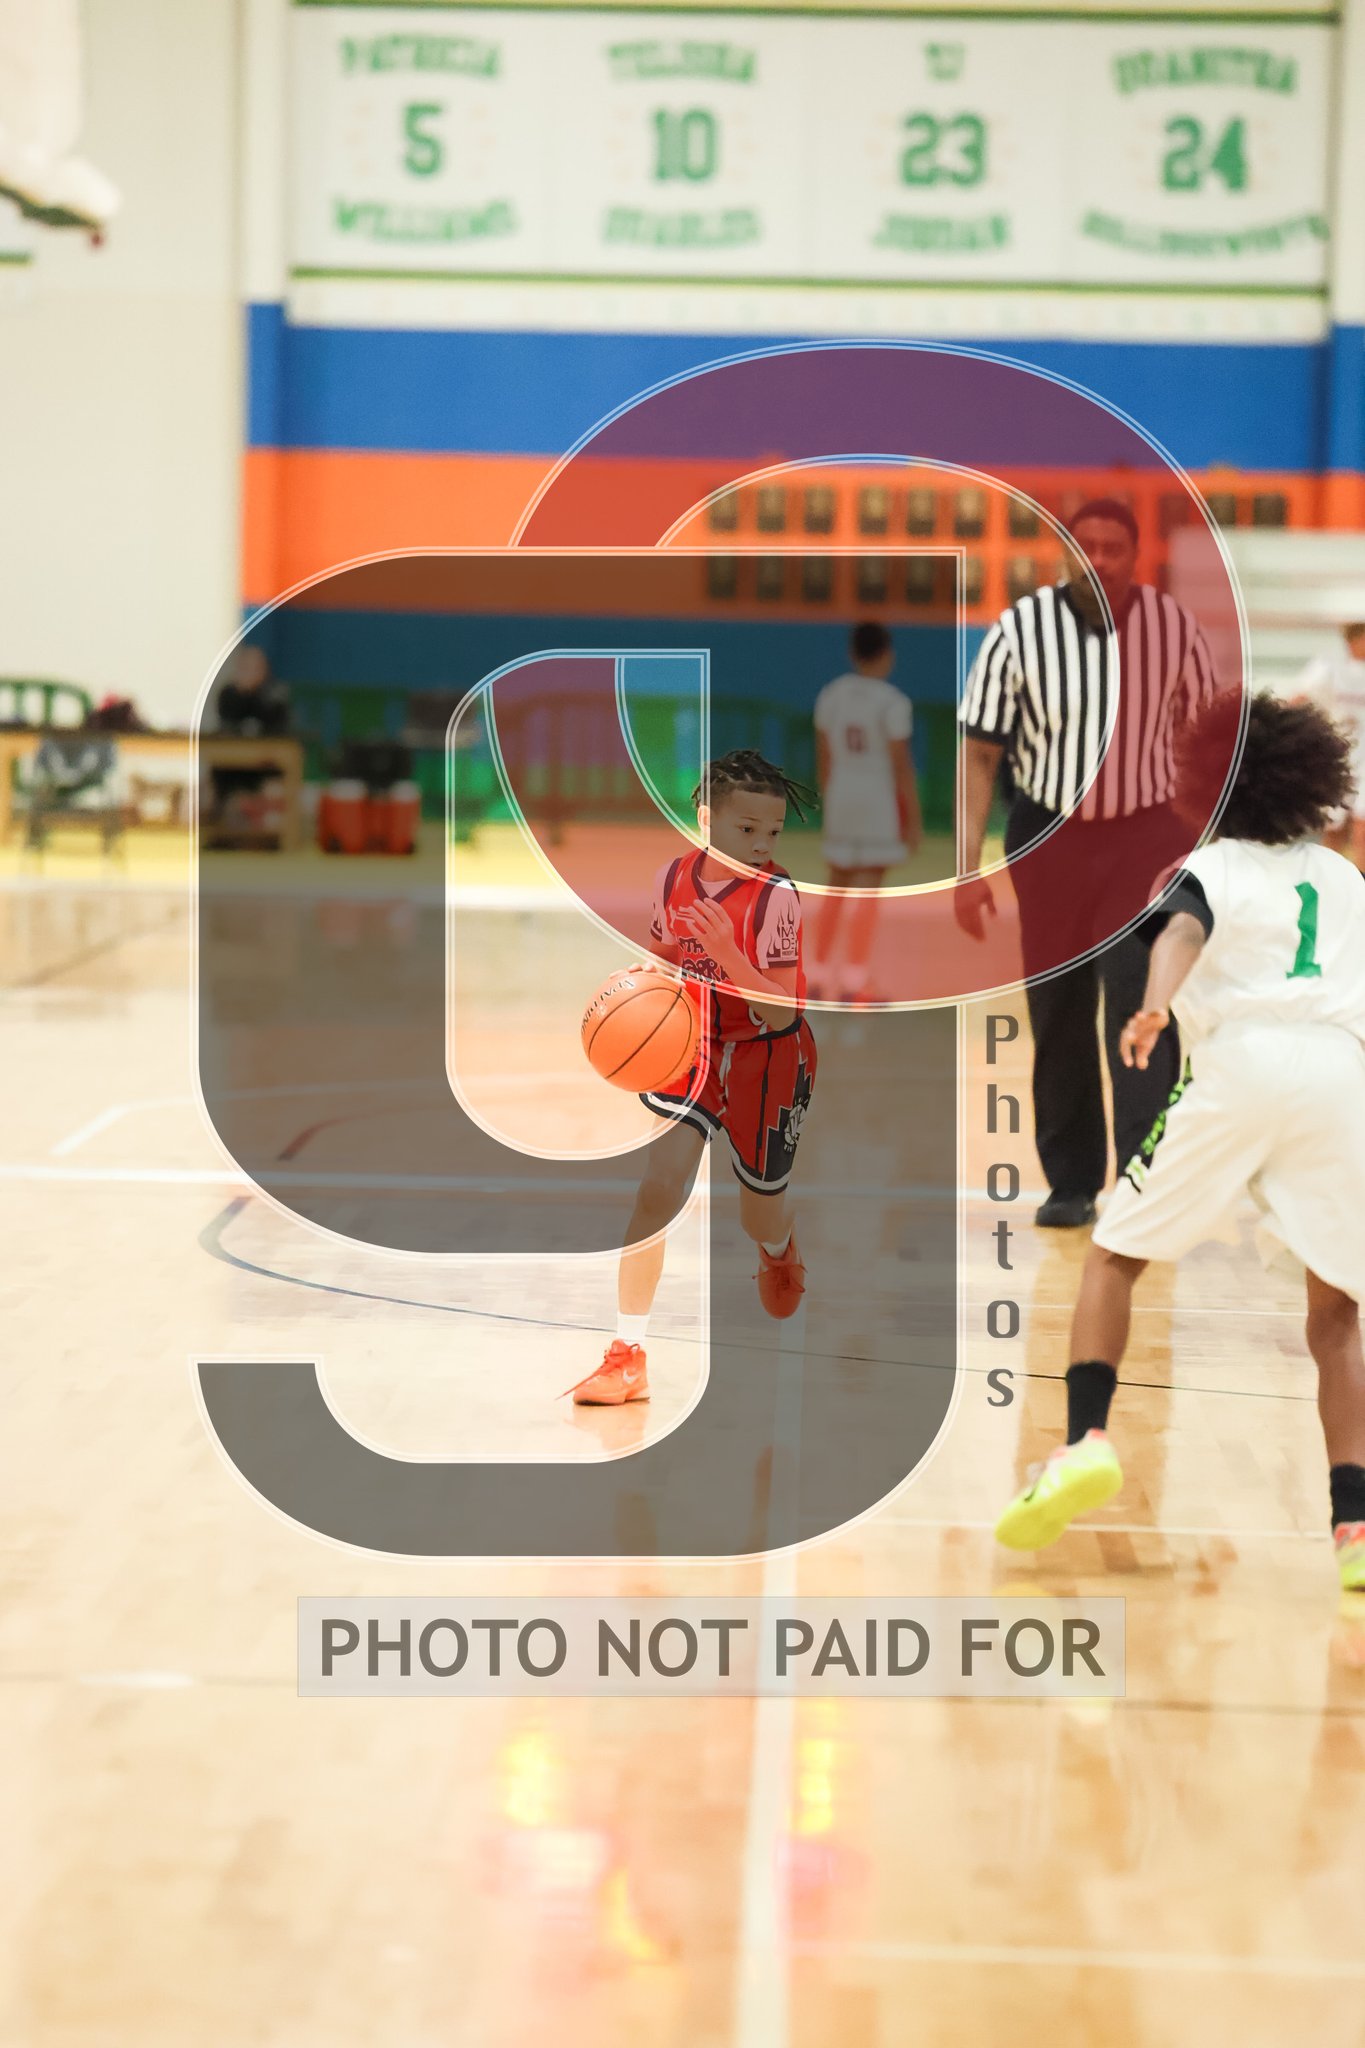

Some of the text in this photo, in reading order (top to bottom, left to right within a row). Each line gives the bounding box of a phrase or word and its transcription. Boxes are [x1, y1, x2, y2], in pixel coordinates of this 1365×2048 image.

[402, 101, 443, 179] 5
[651, 106, 719, 184] 10
[899, 110, 987, 189] 23
[1162, 113, 1248, 194] 24
[1285, 880, 1323, 979] 1
